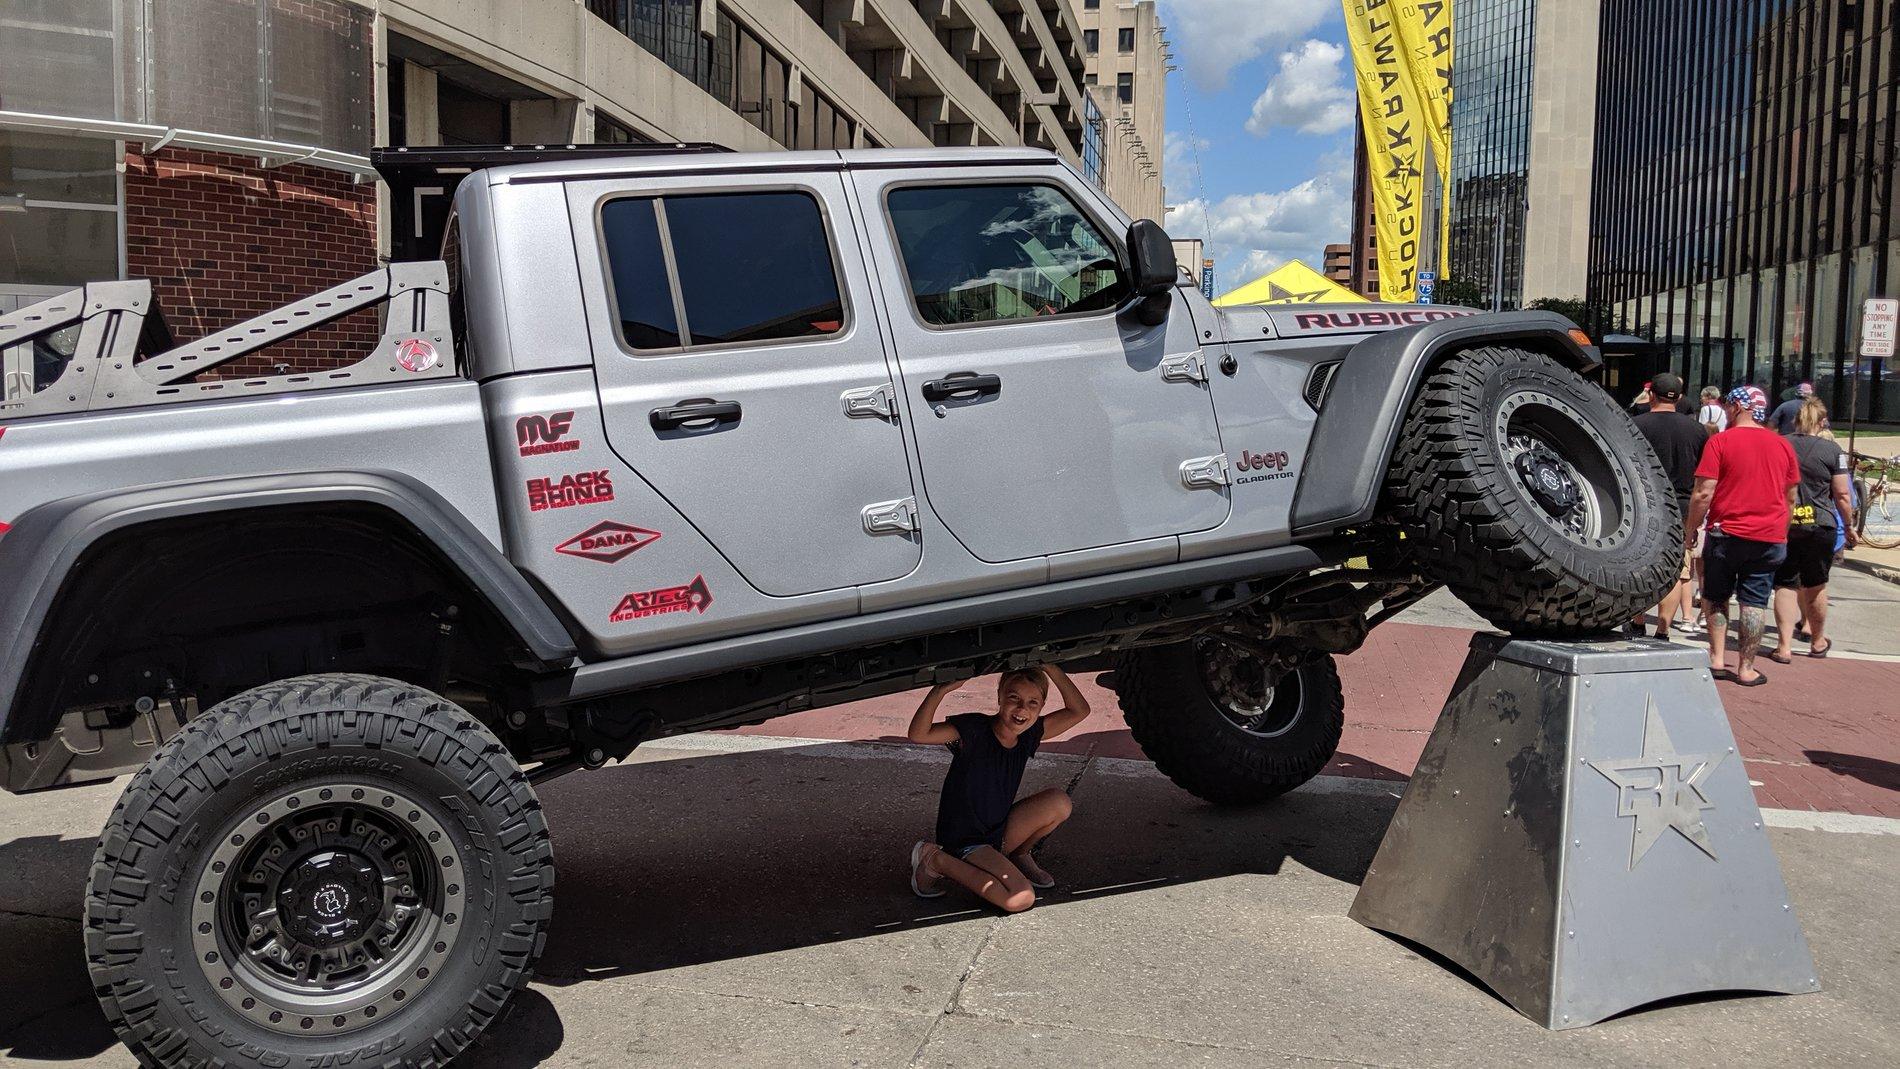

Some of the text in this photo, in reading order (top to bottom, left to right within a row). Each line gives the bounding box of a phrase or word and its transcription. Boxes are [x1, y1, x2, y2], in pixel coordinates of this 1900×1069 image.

[1421, 284, 1432, 292] 75
[1875, 303, 1888, 312] NO
[1866, 313, 1894, 322] STOPPING
[1870, 331, 1887, 339] TIME
[1236, 450, 1289, 472] Jeep
[526, 470, 612, 492] BLACK
[1236, 472, 1294, 485] GLADIATOR
[529, 484, 614, 506] RHINO
[580, 532, 638, 551] DANA
[610, 603, 689, 623] INDUSTRIES
